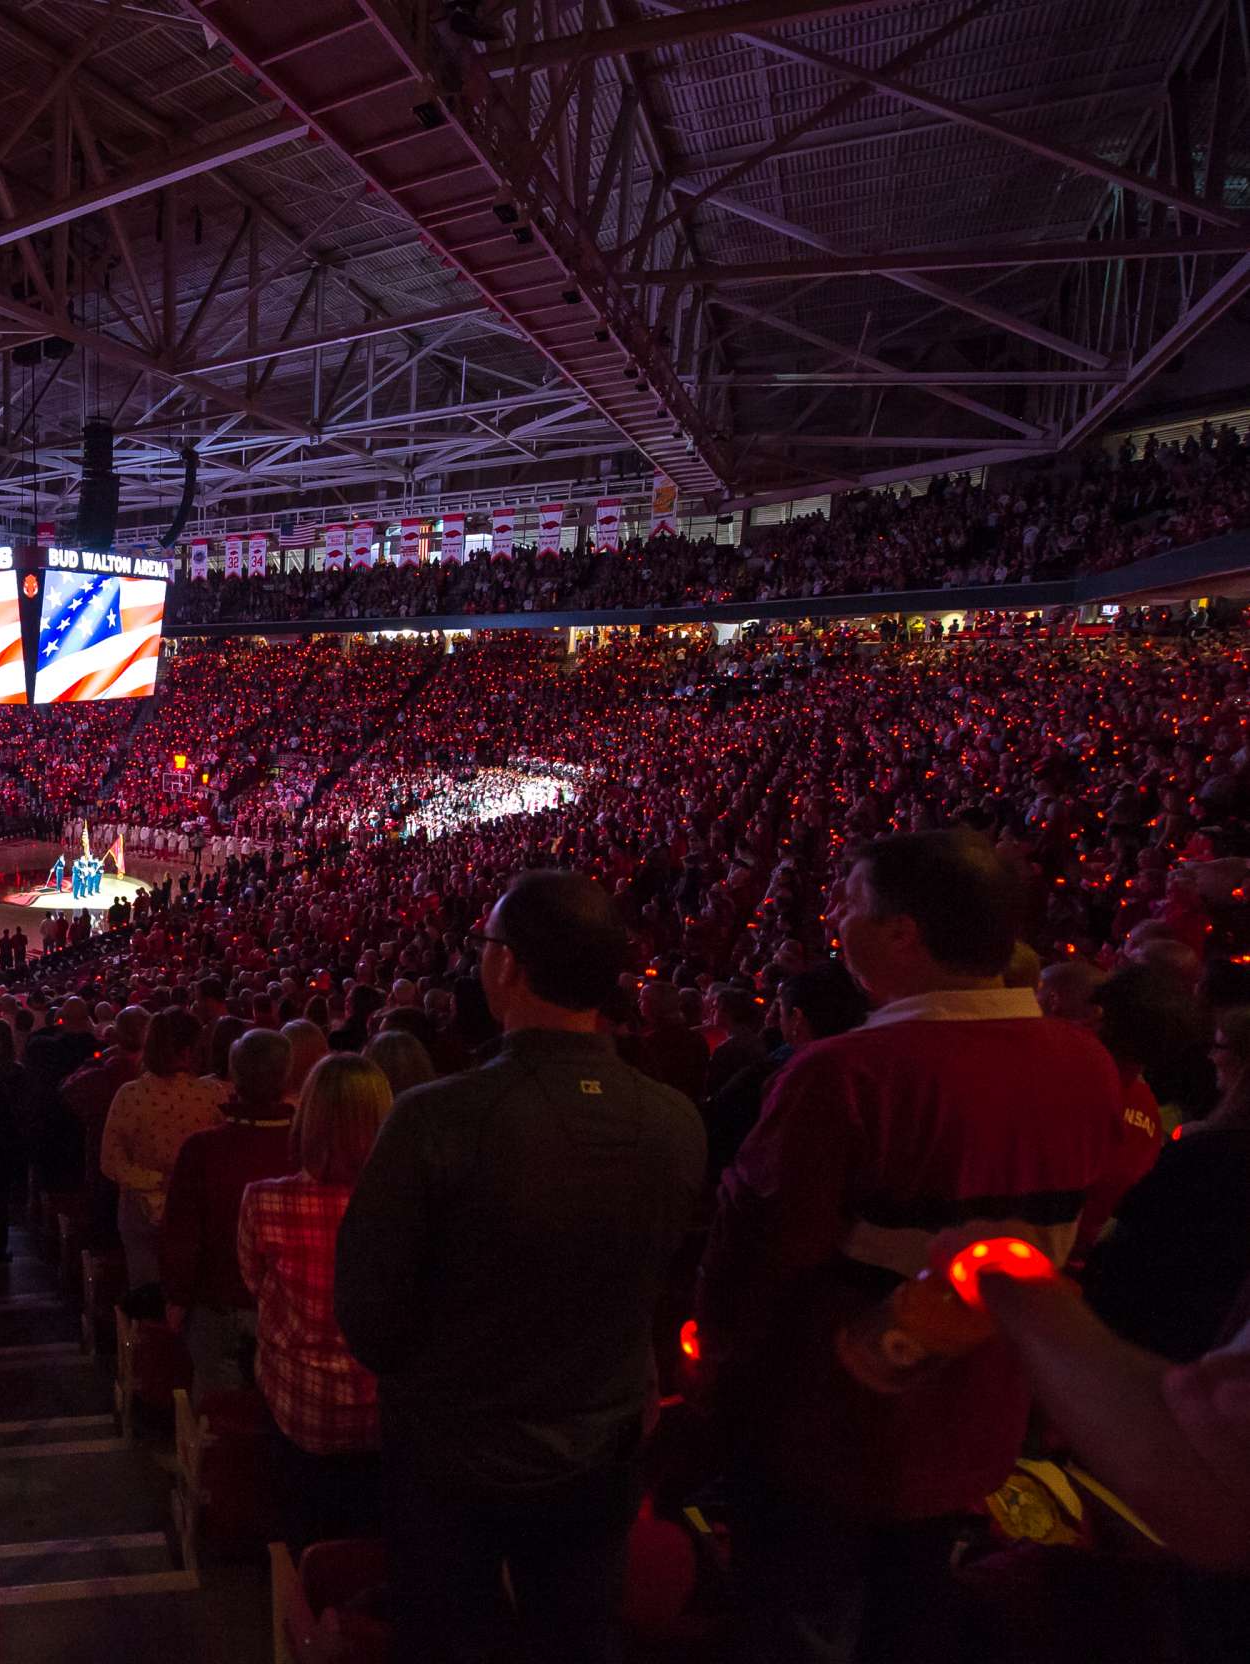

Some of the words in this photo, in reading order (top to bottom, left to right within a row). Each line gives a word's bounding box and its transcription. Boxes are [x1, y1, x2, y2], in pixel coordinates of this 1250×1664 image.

[48, 548, 79, 568] BUD
[82, 551, 131, 574] WALTON
[134, 558, 169, 578] ARENA
[228, 556, 239, 569] 32
[251, 555, 263, 568] 34
